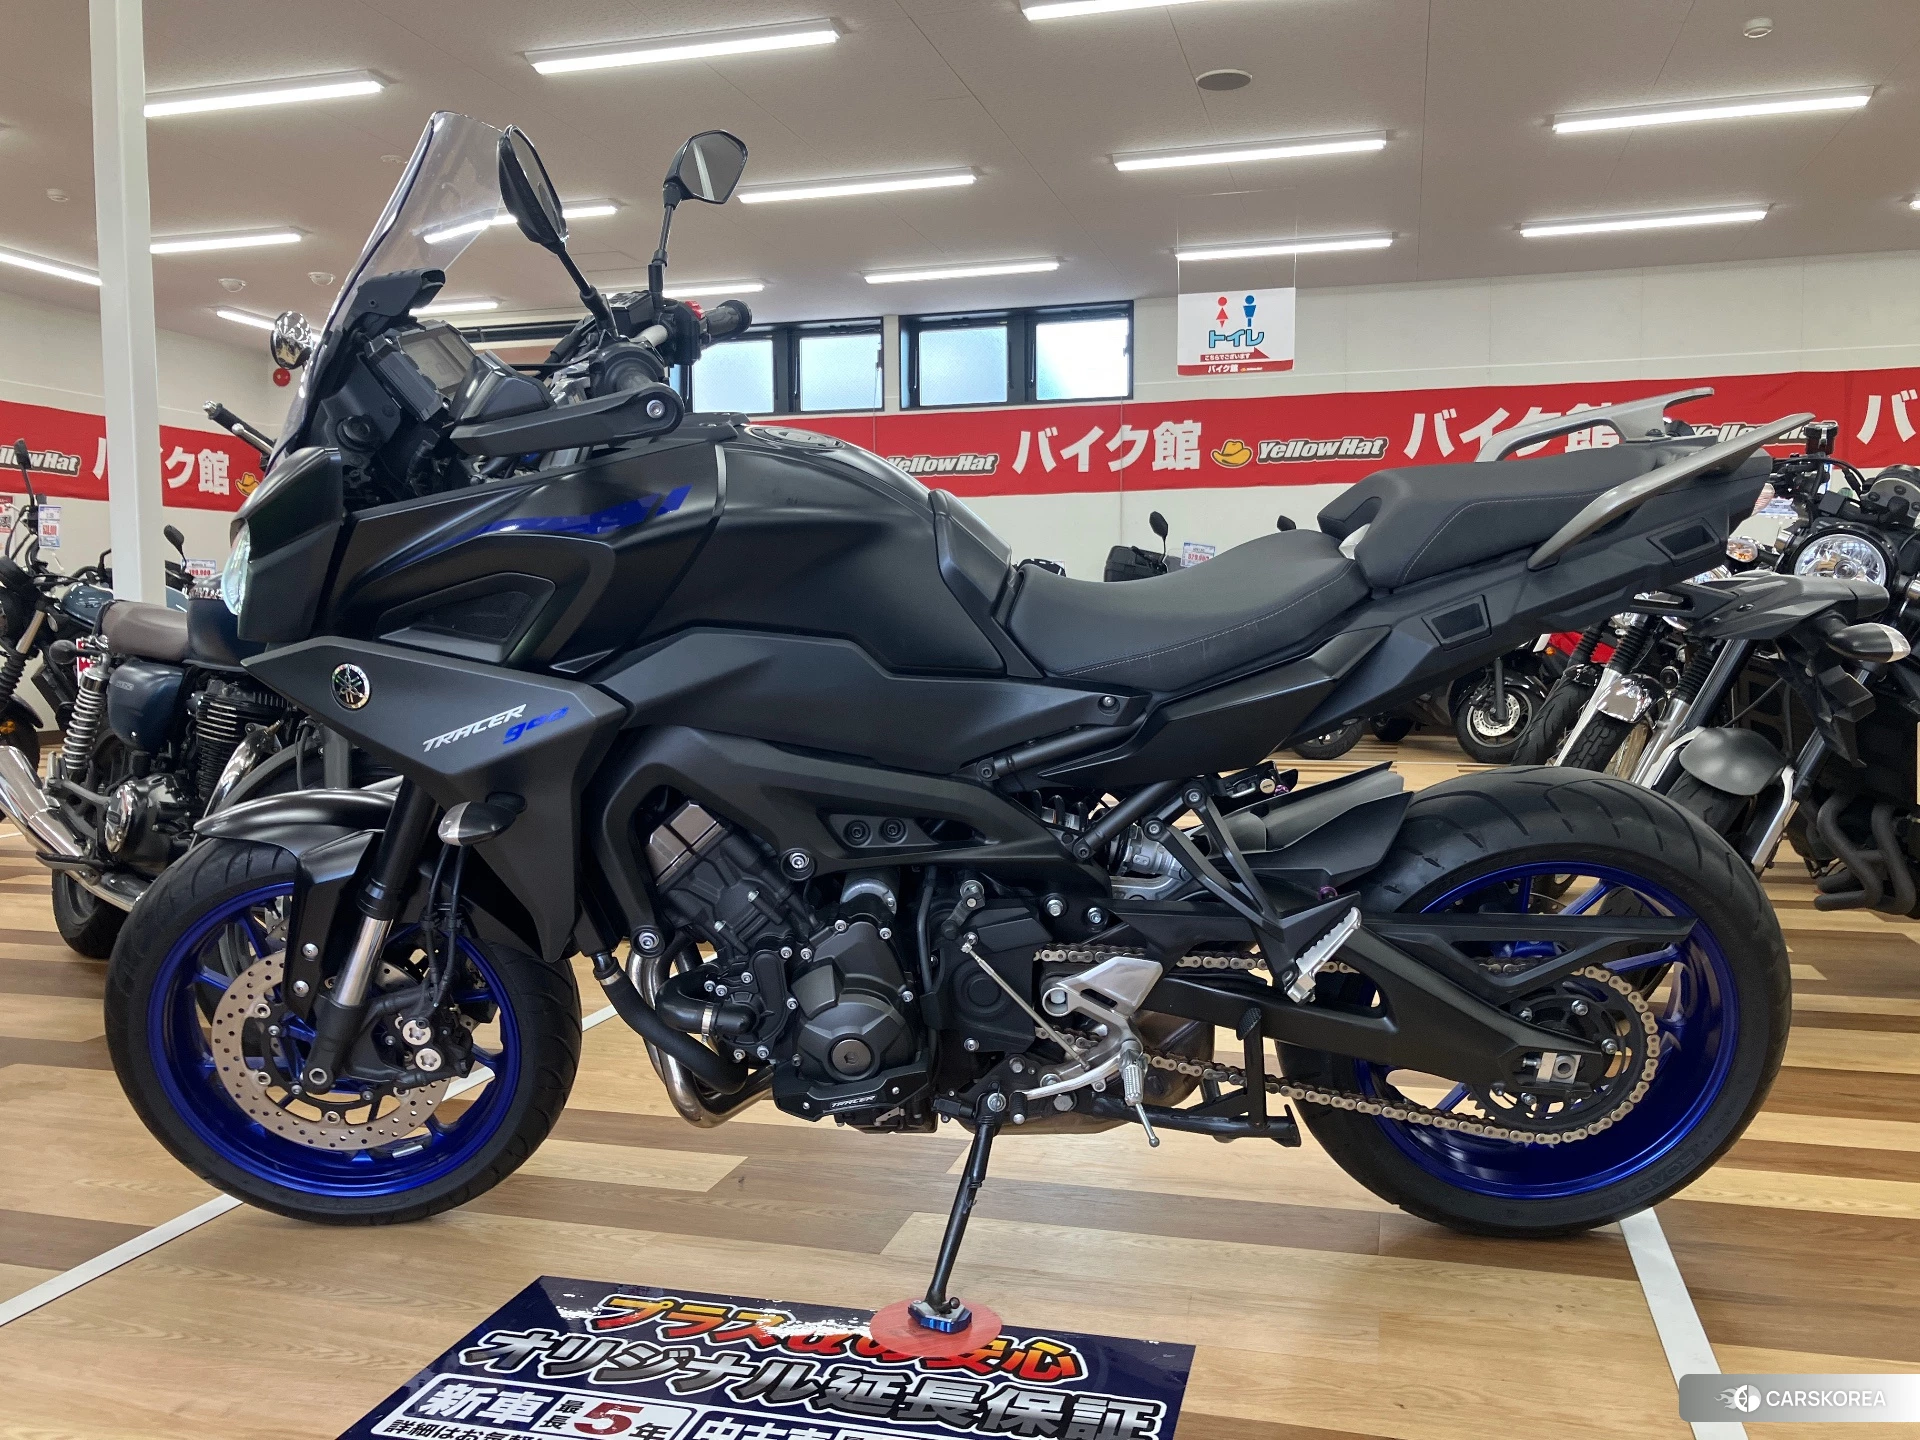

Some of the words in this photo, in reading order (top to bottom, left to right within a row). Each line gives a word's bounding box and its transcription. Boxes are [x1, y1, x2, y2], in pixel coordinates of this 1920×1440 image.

[1208, 329, 1265, 348] トイレ
[1012, 420, 1202, 475] バイク館
[422, 703, 527, 752] TRACER
[418, 1382, 553, 1425] 新車
[461, 1329, 1166, 1440] オリジナル延長保証
